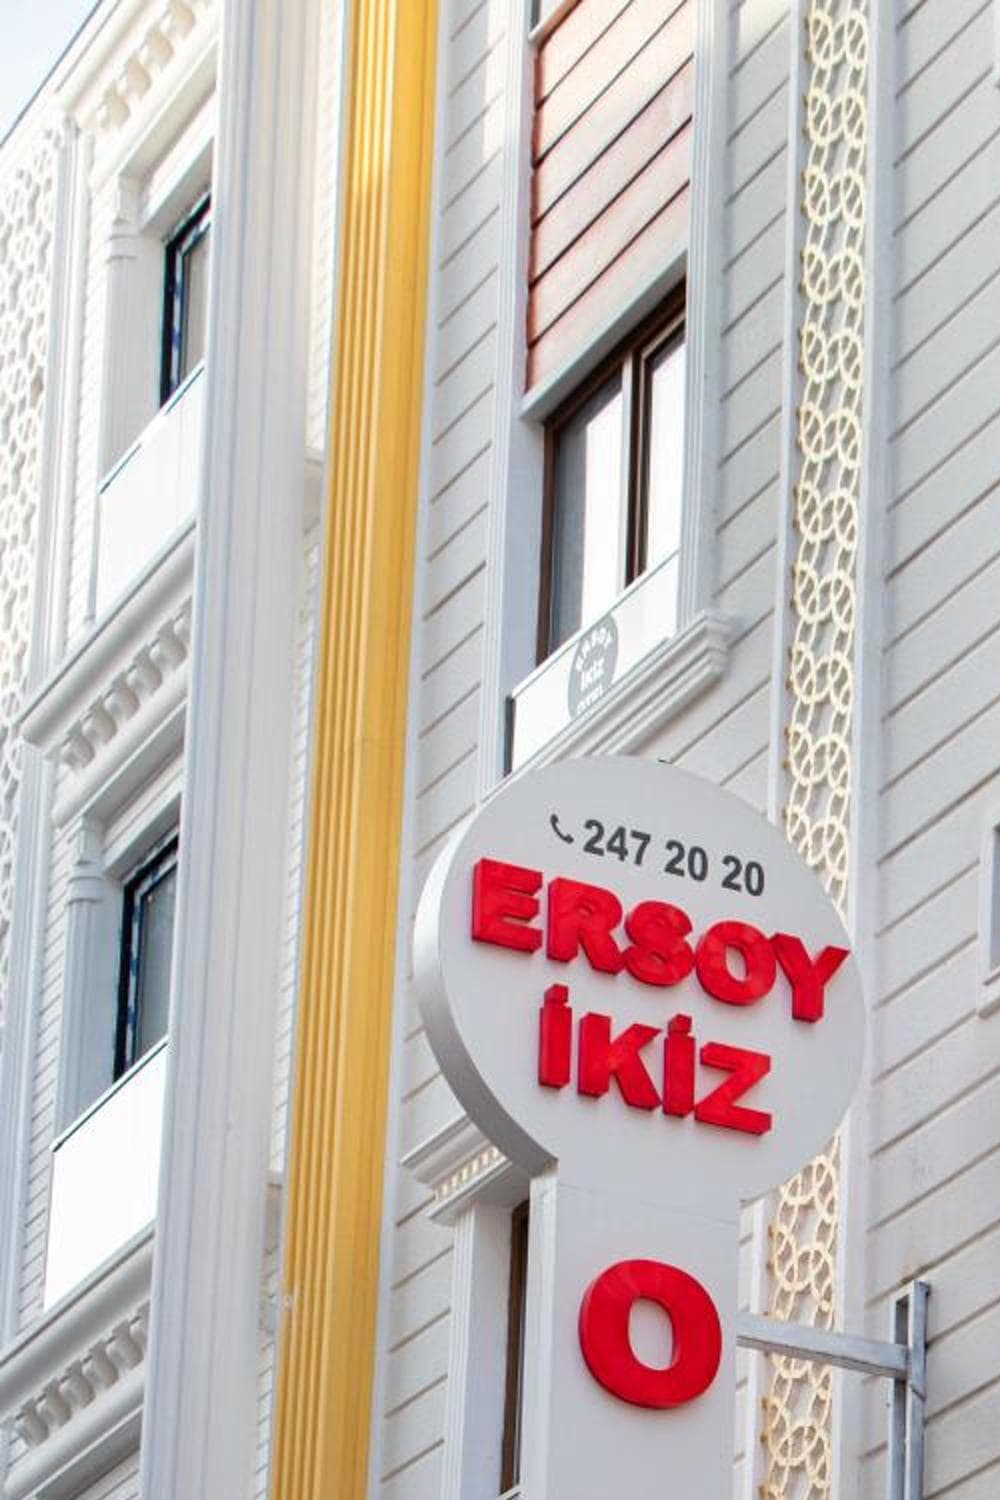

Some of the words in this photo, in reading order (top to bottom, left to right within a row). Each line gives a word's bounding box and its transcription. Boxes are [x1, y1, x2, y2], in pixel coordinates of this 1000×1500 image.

[583, 819, 651, 867] 247
[664, 839, 709, 882] 20
[721, 854, 766, 897] 20
[472, 857, 851, 1024] ERSOY
[538, 983, 772, 1137] İKİZ
